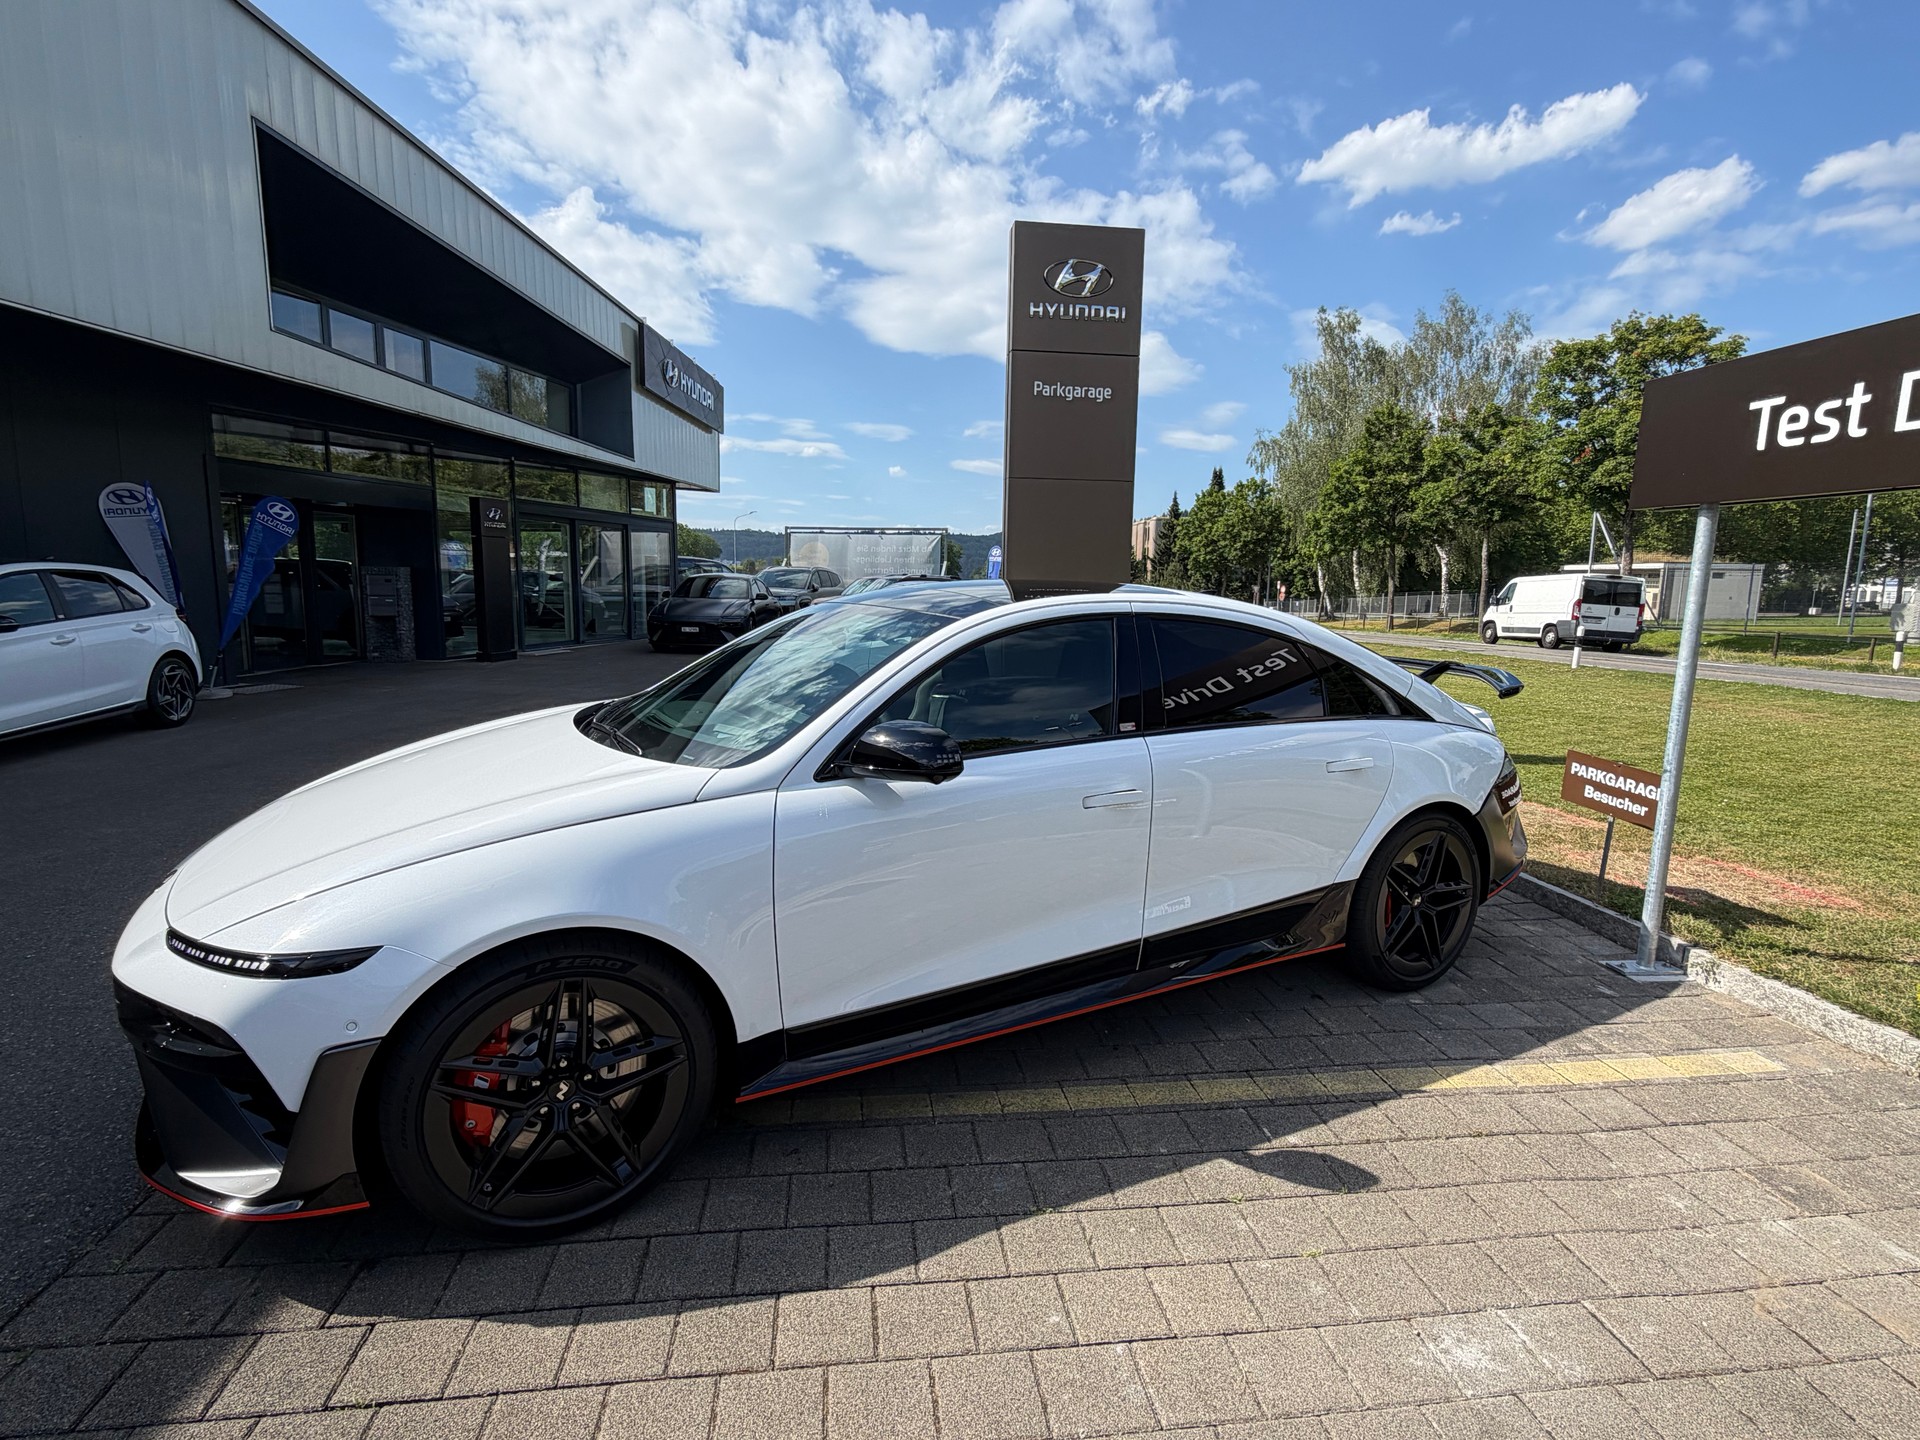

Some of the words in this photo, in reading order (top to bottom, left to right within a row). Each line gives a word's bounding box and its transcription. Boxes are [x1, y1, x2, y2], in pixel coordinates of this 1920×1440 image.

[1029, 302, 1126, 323] HYUNDAI
[680, 371, 714, 411] HYUNDAI
[1033, 380, 1112, 402] Parkgarage
[1749, 381, 1872, 451] Test
[256, 511, 295, 536] HYUNDAI
[1584, 785, 1648, 817] Besucher
